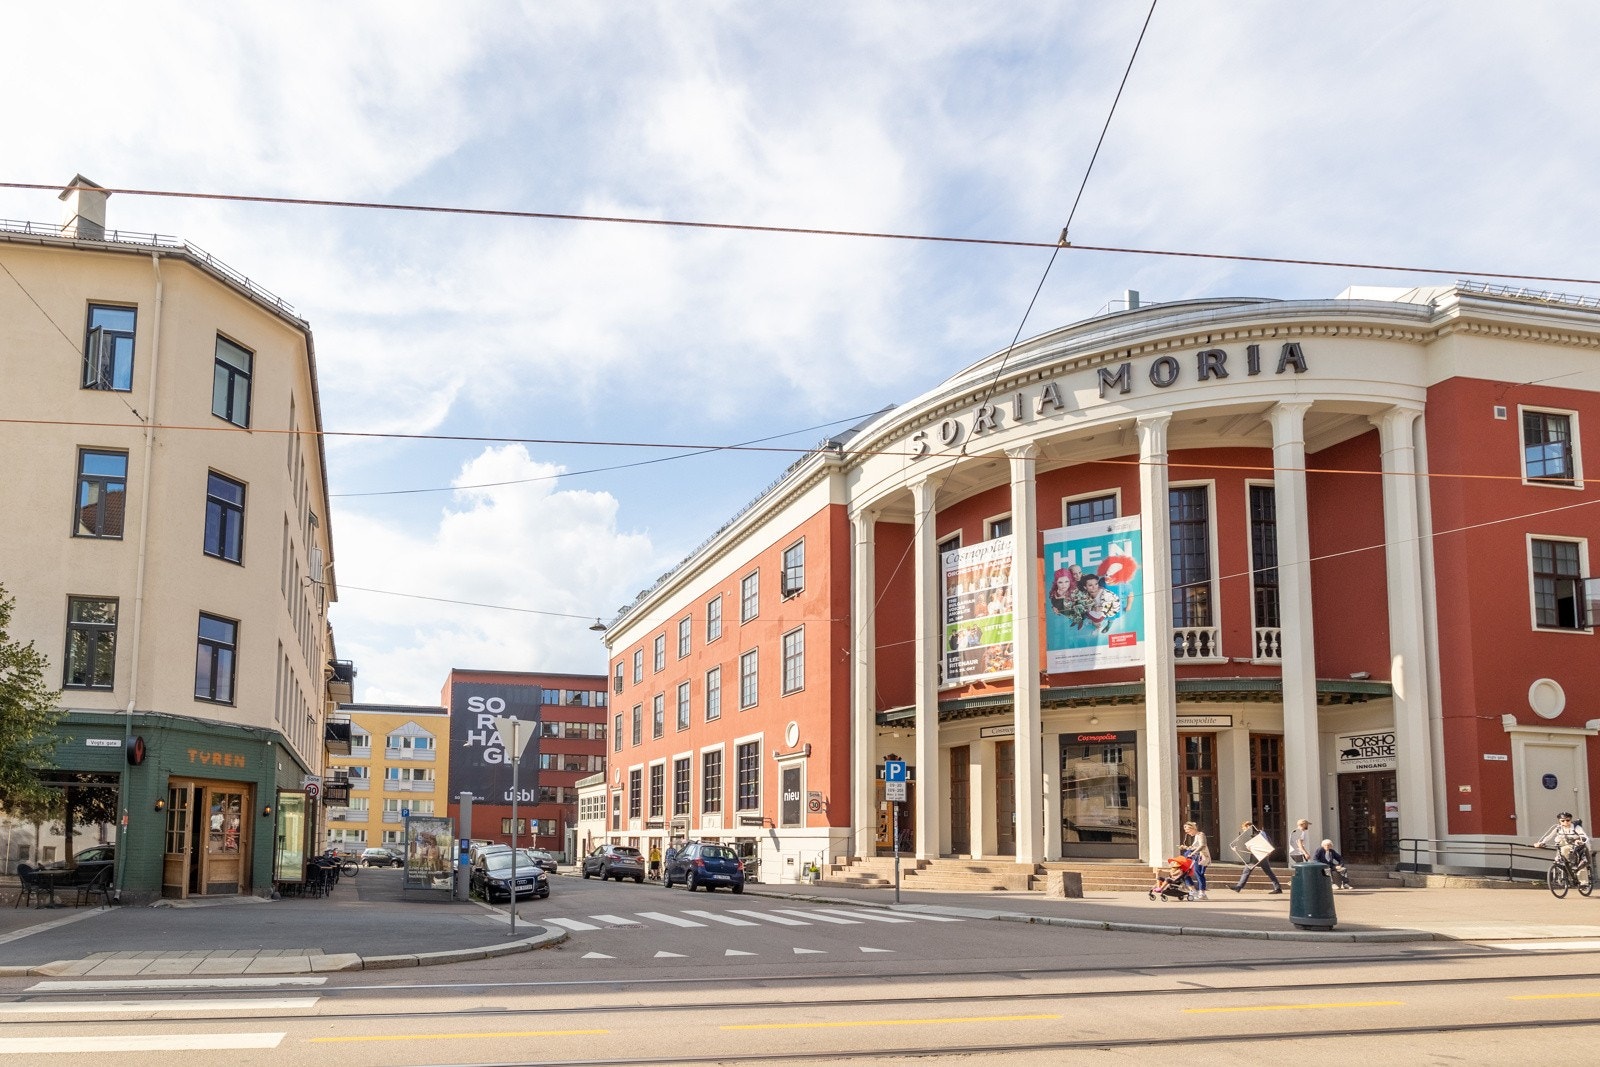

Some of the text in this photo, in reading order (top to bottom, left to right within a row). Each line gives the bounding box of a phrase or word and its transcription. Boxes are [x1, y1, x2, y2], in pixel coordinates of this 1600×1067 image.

[910, 342, 1308, 461] SORIA MORIA
[1054, 540, 1133, 571] HEN
[467, 696, 506, 713] SO
[1176, 716, 1217, 725] osmopolite
[1077, 733, 1117, 742] Cosmopolite
[1349, 734, 1395, 748] TORSHO
[1359, 745, 1395, 757] TEATRE
[891, 764, 901, 779] P
[784, 789, 799, 801] nieu
